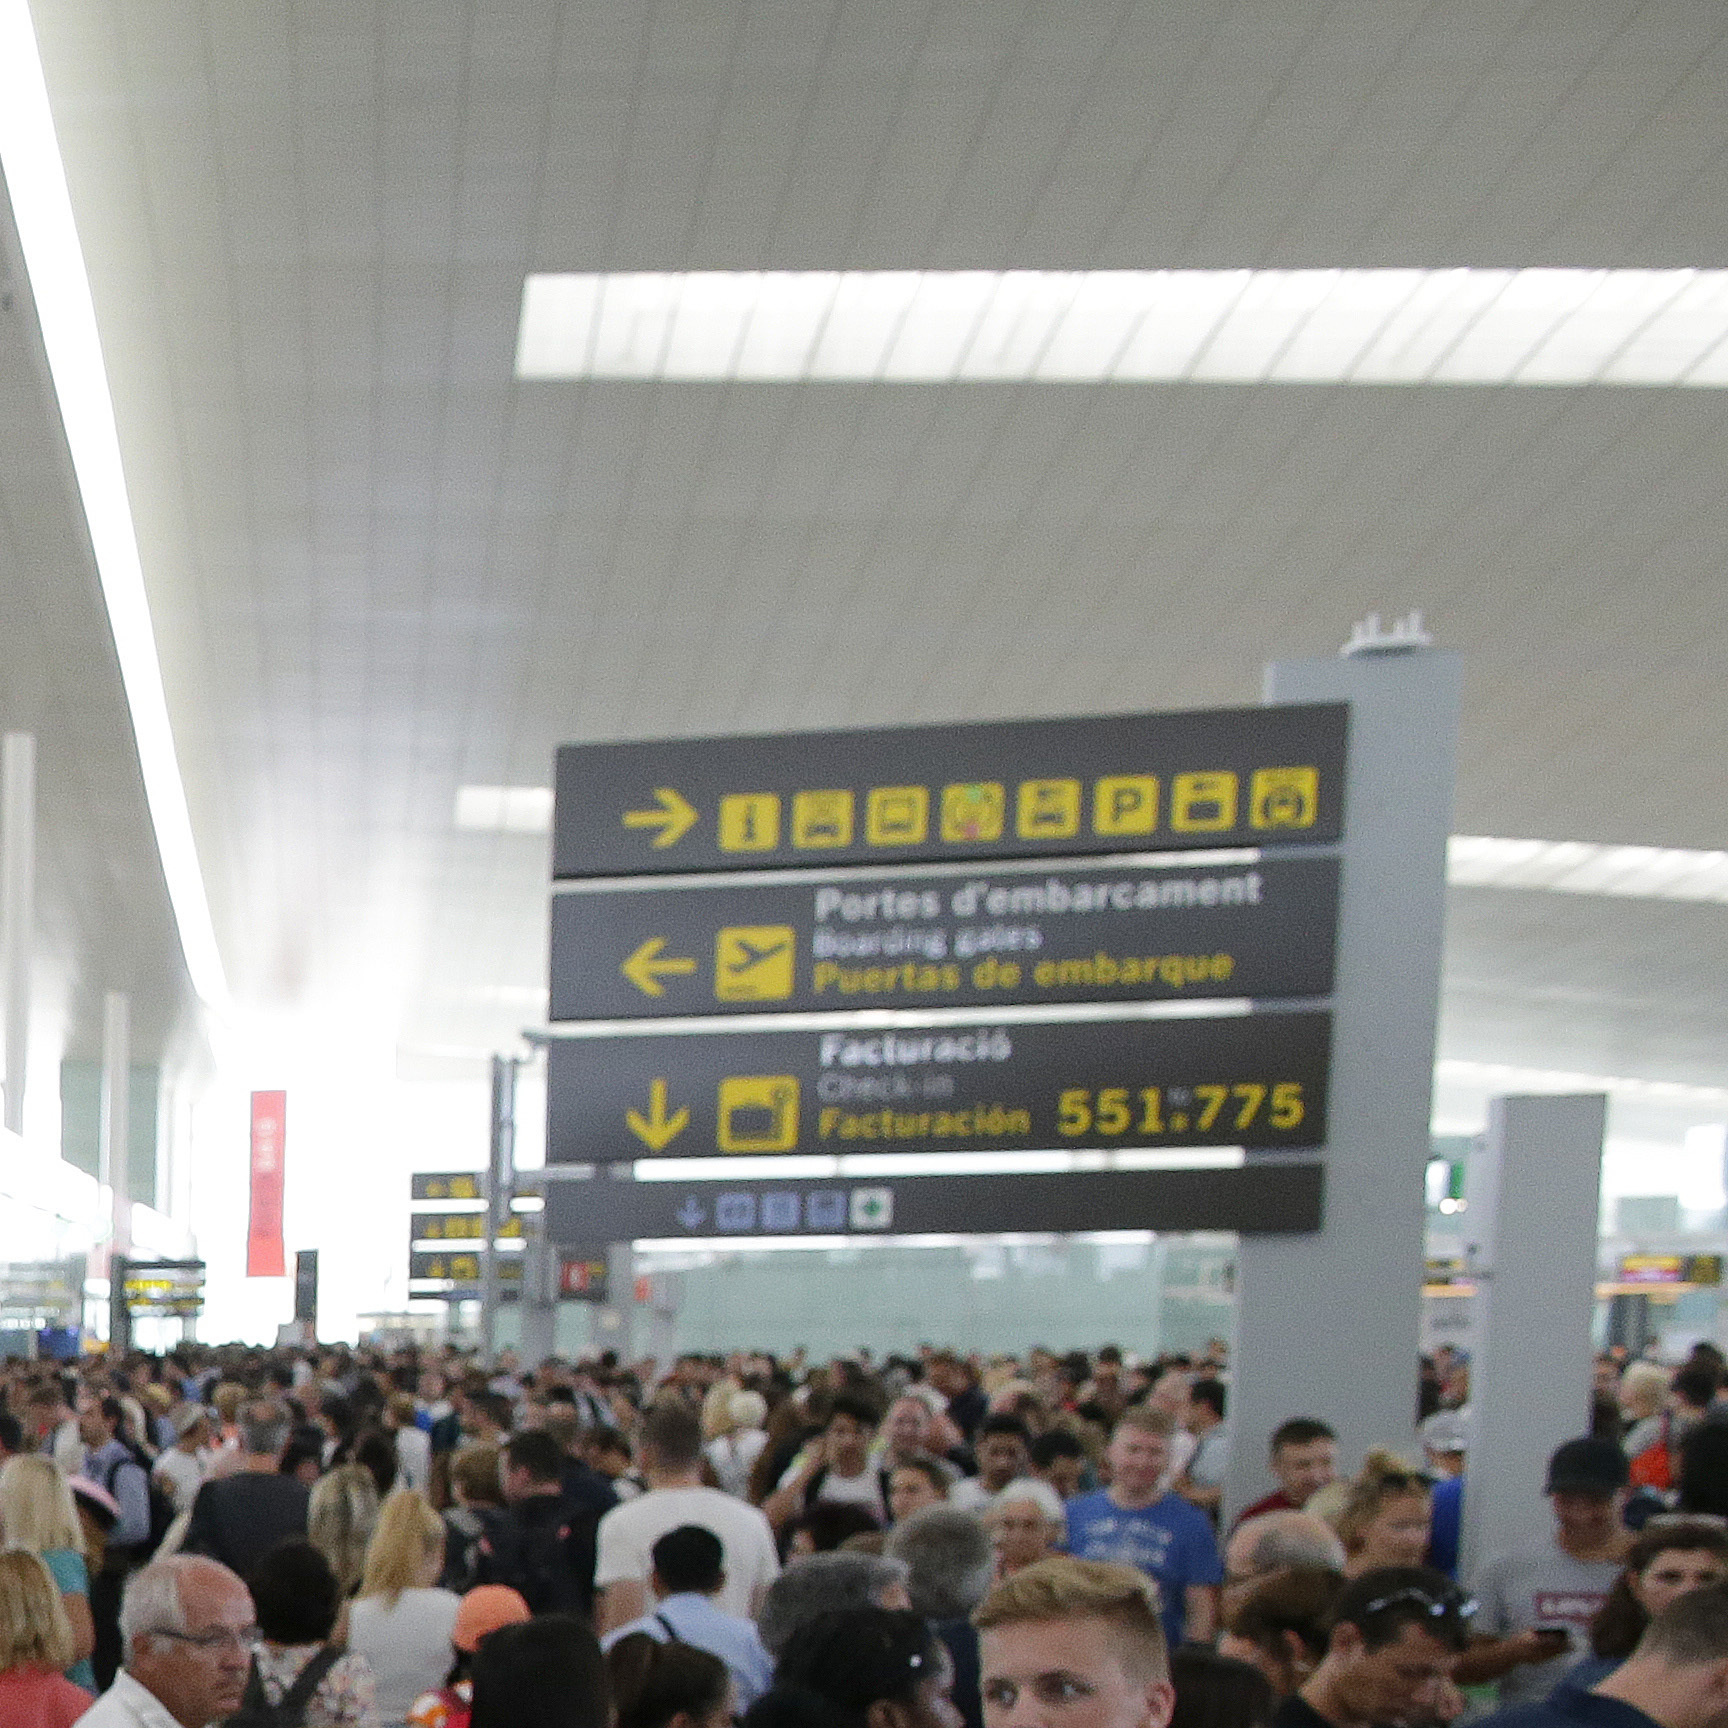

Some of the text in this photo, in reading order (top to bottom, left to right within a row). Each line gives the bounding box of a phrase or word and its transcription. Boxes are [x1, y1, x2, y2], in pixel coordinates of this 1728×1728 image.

[813, 872, 1263, 922] Portes d'embarcament
[812, 924, 1042, 958] Boarding gates
[813, 952, 1235, 994] Puertas de embarque
[819, 1029, 1012, 1067] Facturació
[819, 1103, 1031, 1140] Facturación
